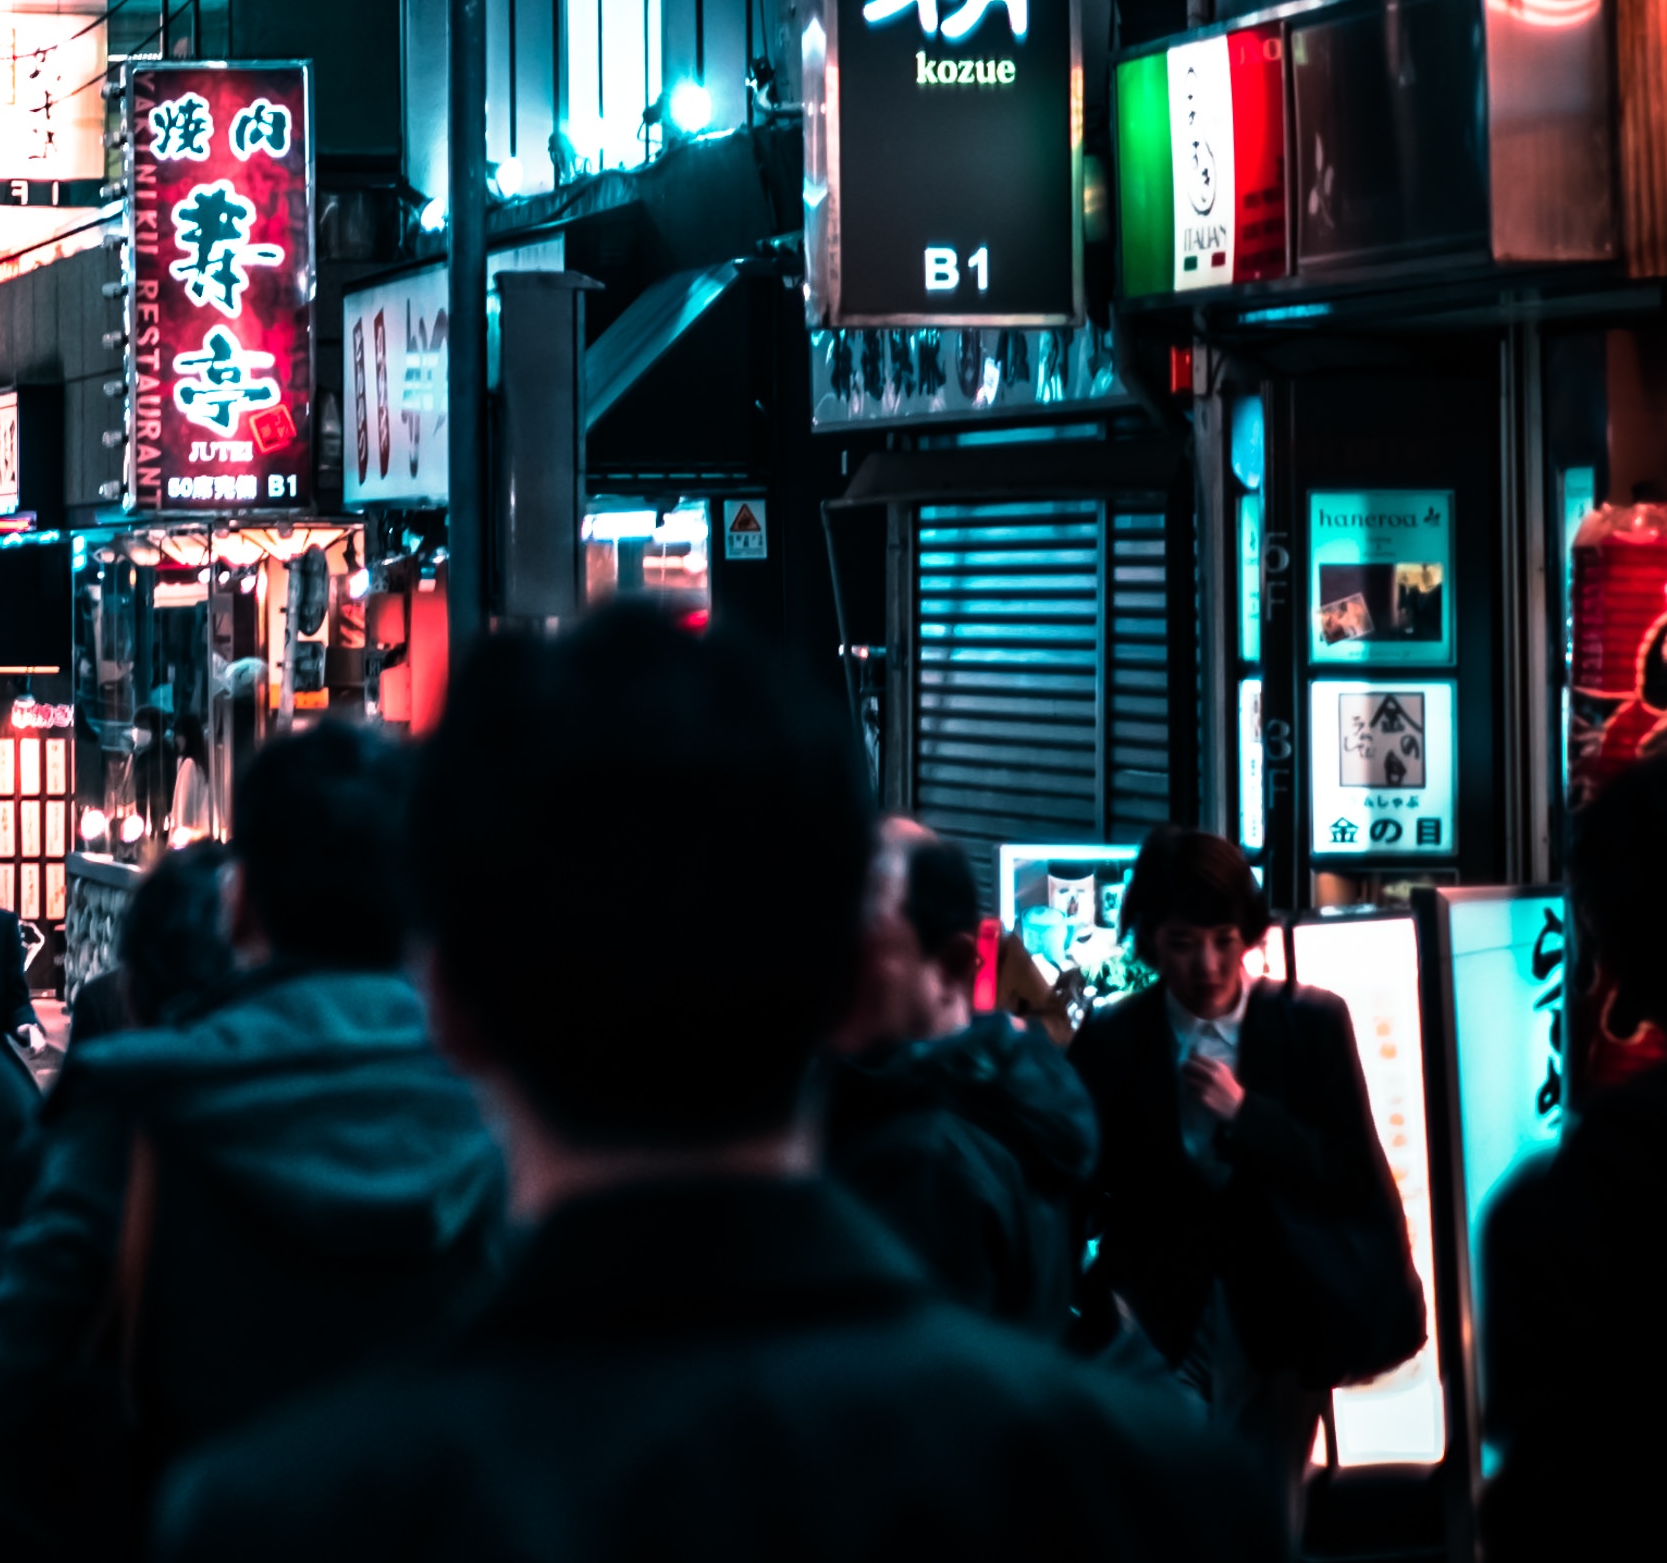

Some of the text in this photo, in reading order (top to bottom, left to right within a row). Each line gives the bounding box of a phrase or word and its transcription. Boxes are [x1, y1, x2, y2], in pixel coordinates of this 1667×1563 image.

[915, 50, 1016, 86] kozue
[149, 92, 292, 162] 焼肉
[922, 245, 990, 294] B1
[133, 72, 165, 511] YAKINIKU RESTAURANT
[267, 474, 299, 499] B1
[1328, 816, 1443, 846] 金の目
